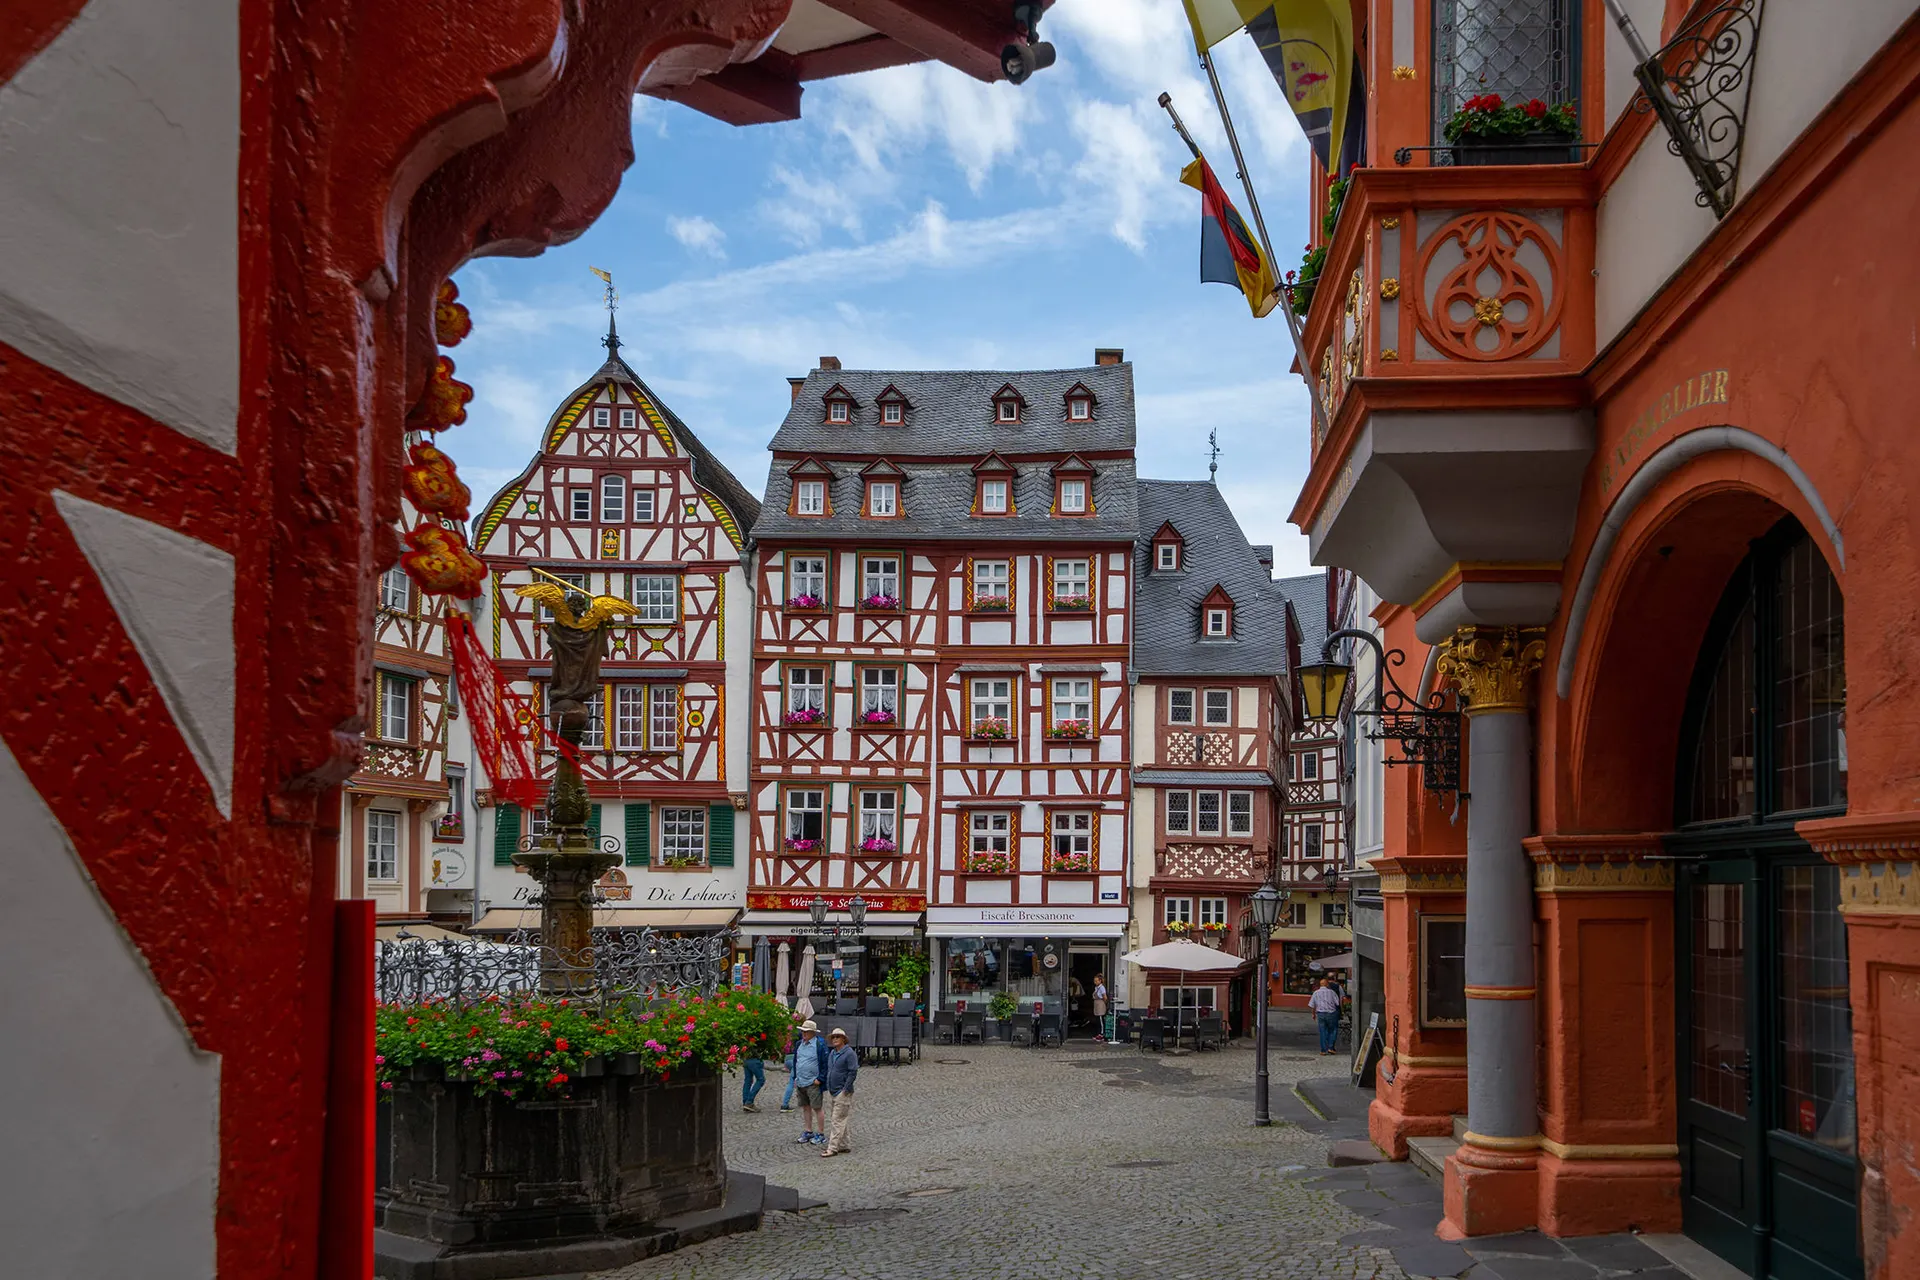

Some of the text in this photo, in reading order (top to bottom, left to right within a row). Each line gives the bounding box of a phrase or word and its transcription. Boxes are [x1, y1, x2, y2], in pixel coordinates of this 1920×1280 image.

[647, 886, 675, 901] Die
[981, 909, 1075, 921] Eiscafé Bressanone
